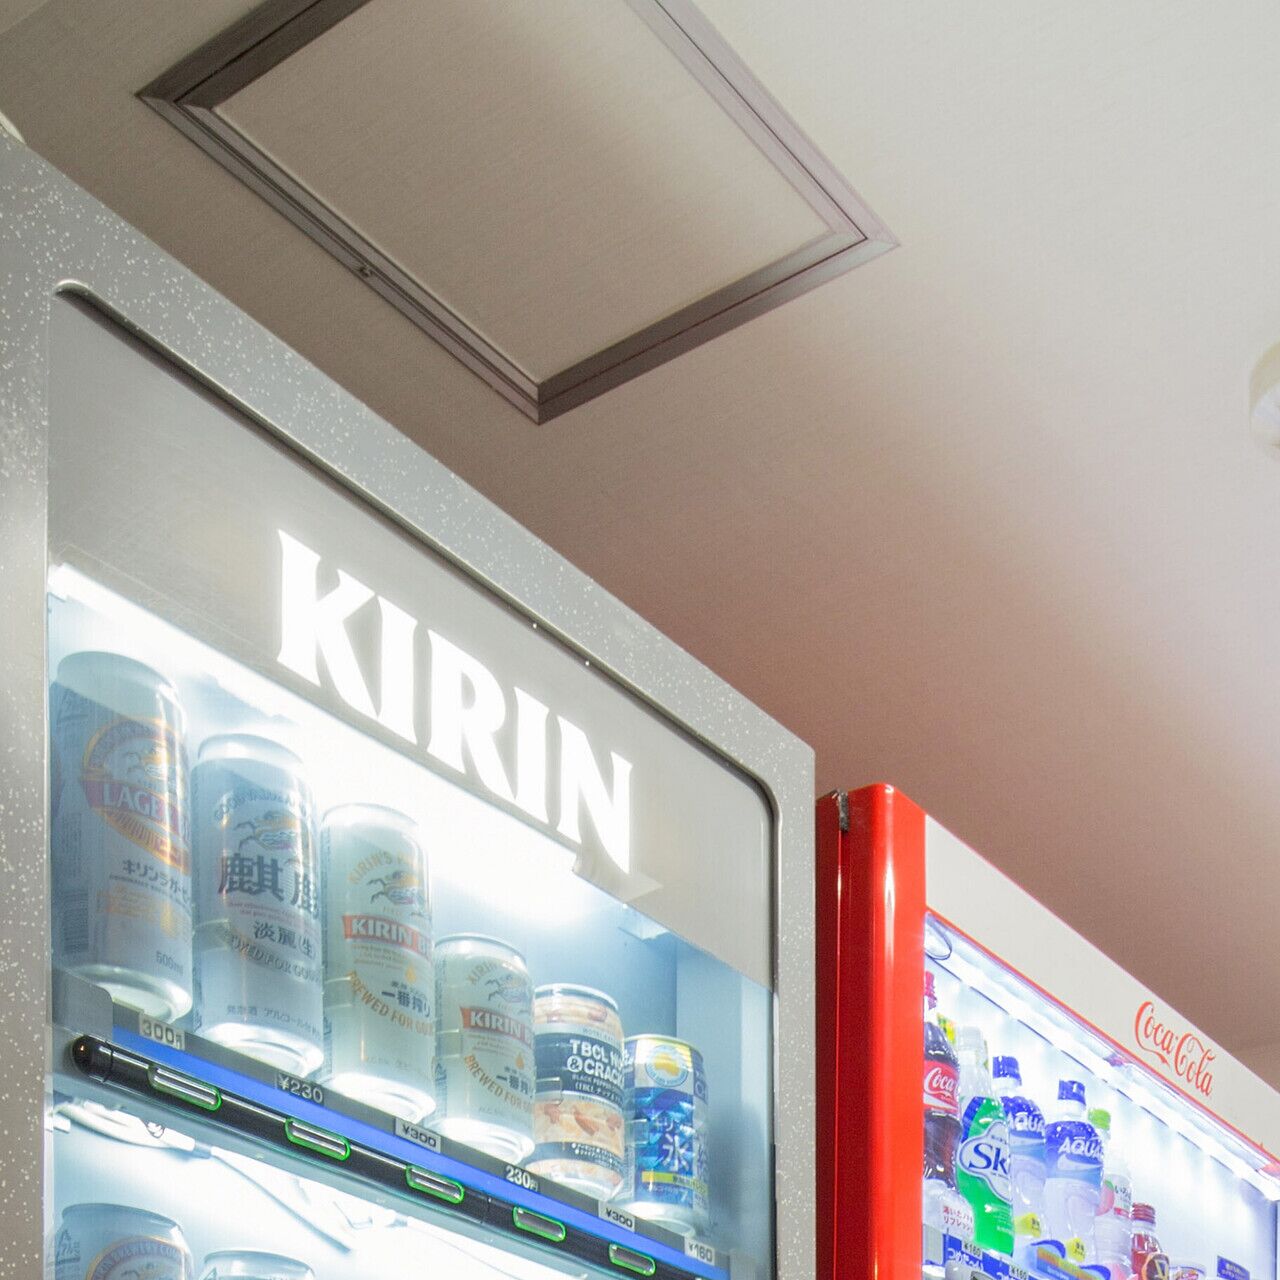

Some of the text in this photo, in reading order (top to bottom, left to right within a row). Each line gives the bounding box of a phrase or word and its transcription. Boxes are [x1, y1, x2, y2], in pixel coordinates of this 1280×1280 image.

[276, 528, 633, 875] KIRIN
[352, 918, 413, 950] KIRIN
[348, 970, 389, 1017] BREWED
[469, 1010, 523, 1038] KIRIN
[1134, 1001, 1217, 1097] Coca-Cola
[279, 1075, 323, 1104] ¥230
[465, 1054, 503, 1098] BREWED
[402, 1123, 438, 1150] ¥300
[506, 1167, 540, 1193] 230円
[606, 1208, 634, 1228] ¥300
